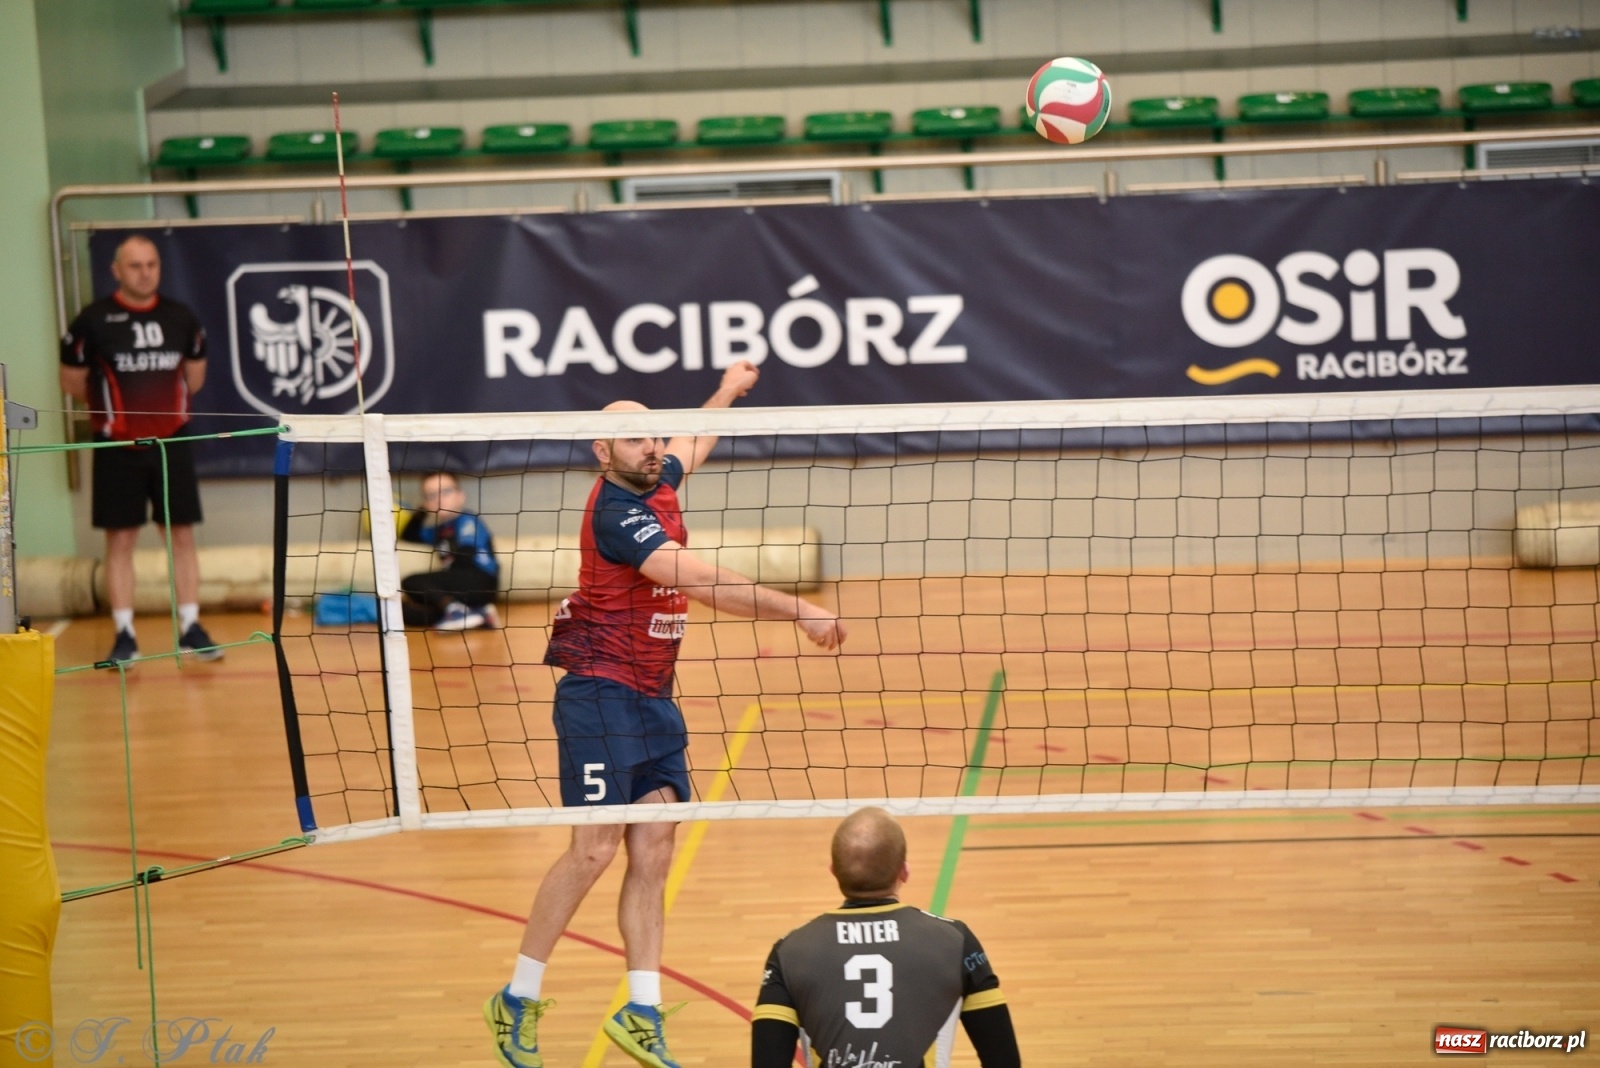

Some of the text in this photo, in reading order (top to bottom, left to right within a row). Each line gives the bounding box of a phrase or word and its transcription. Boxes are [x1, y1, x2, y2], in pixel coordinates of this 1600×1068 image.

[132, 321, 164, 348] 10
[482, 274, 967, 378] RACIBÓRZ
[1296, 341, 1469, 380] RACIBÓRZ
[584, 763, 606, 801] 5
[836, 919, 900, 944] ENTER
[844, 954, 893, 1028] 3
